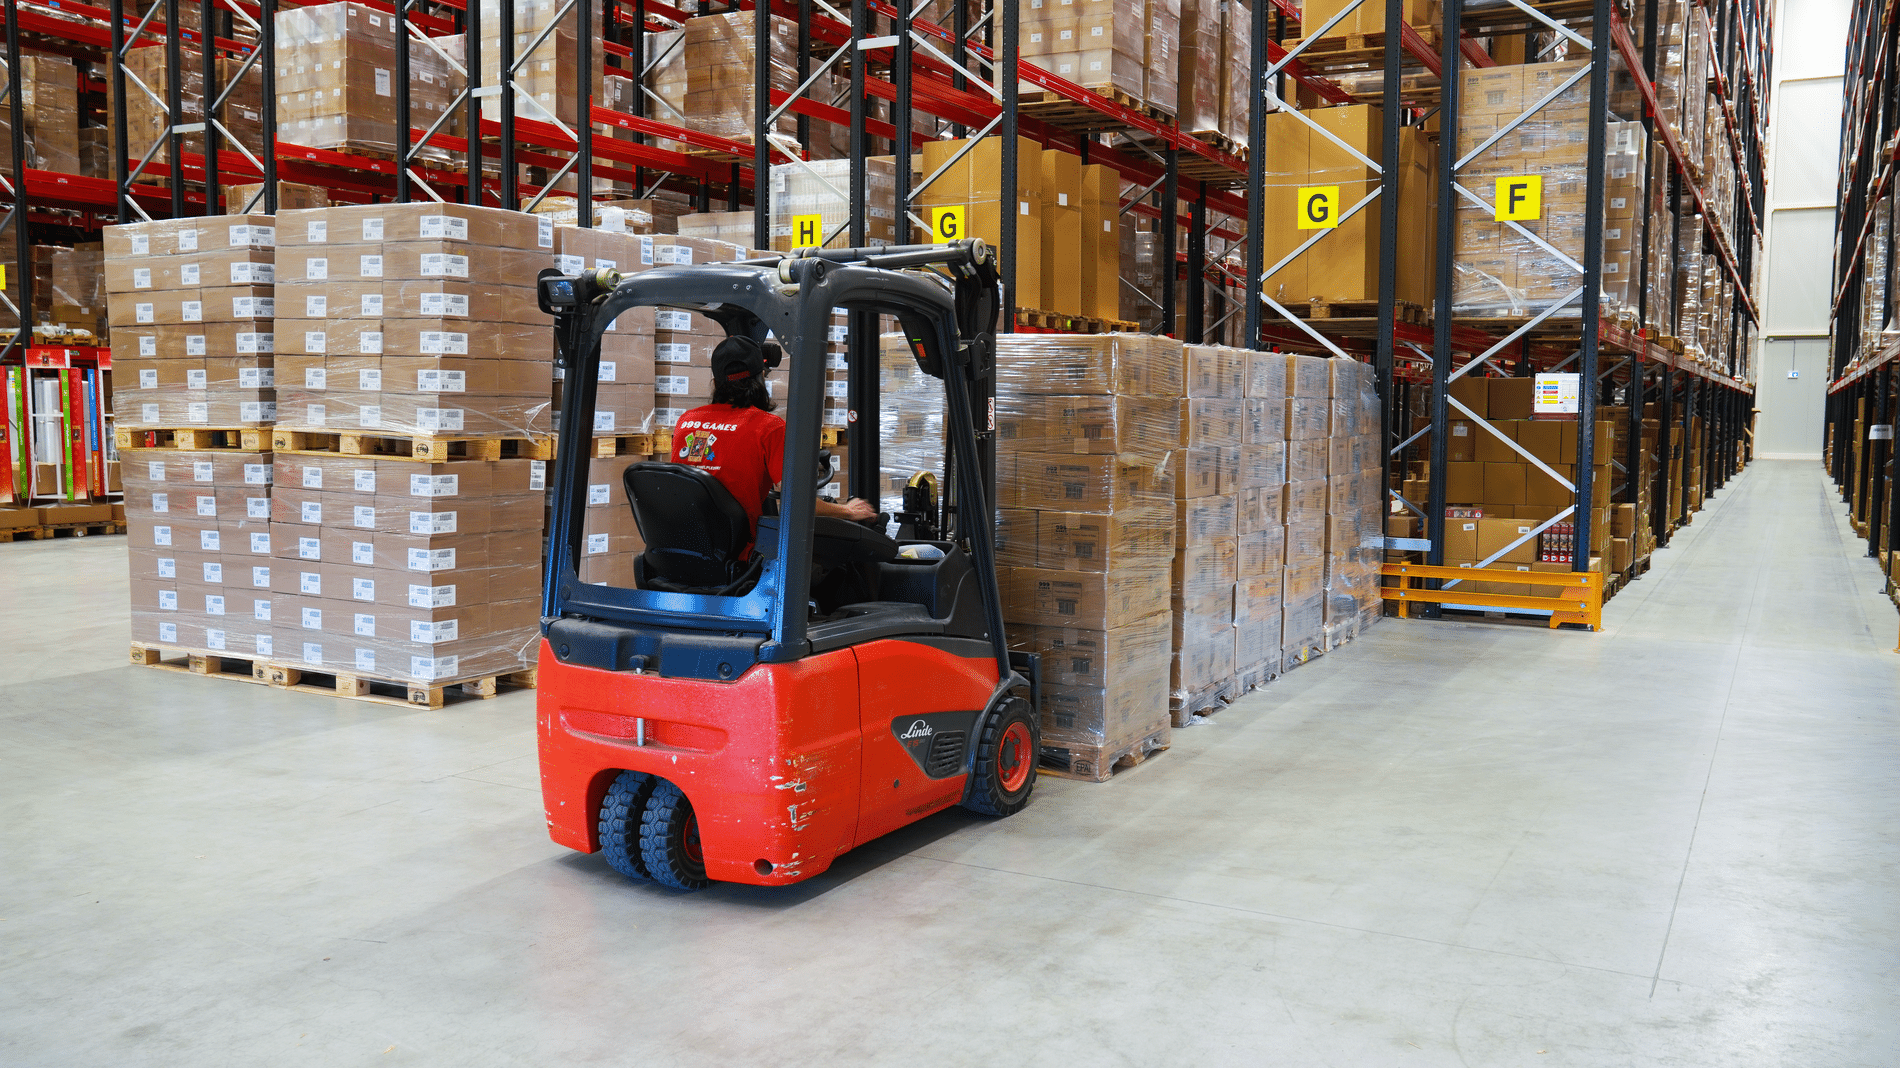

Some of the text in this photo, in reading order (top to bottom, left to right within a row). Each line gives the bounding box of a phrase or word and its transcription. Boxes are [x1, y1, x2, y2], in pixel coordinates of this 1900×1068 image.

[1307, 193, 1328, 222] G
[1509, 183, 1527, 214] F
[800, 220, 813, 245] H
[940, 212, 957, 238] G
[681, 421, 737, 431] 999 GAMES
[901, 719, 932, 739] Linde
[1076, 763, 1091, 772] EPAL
